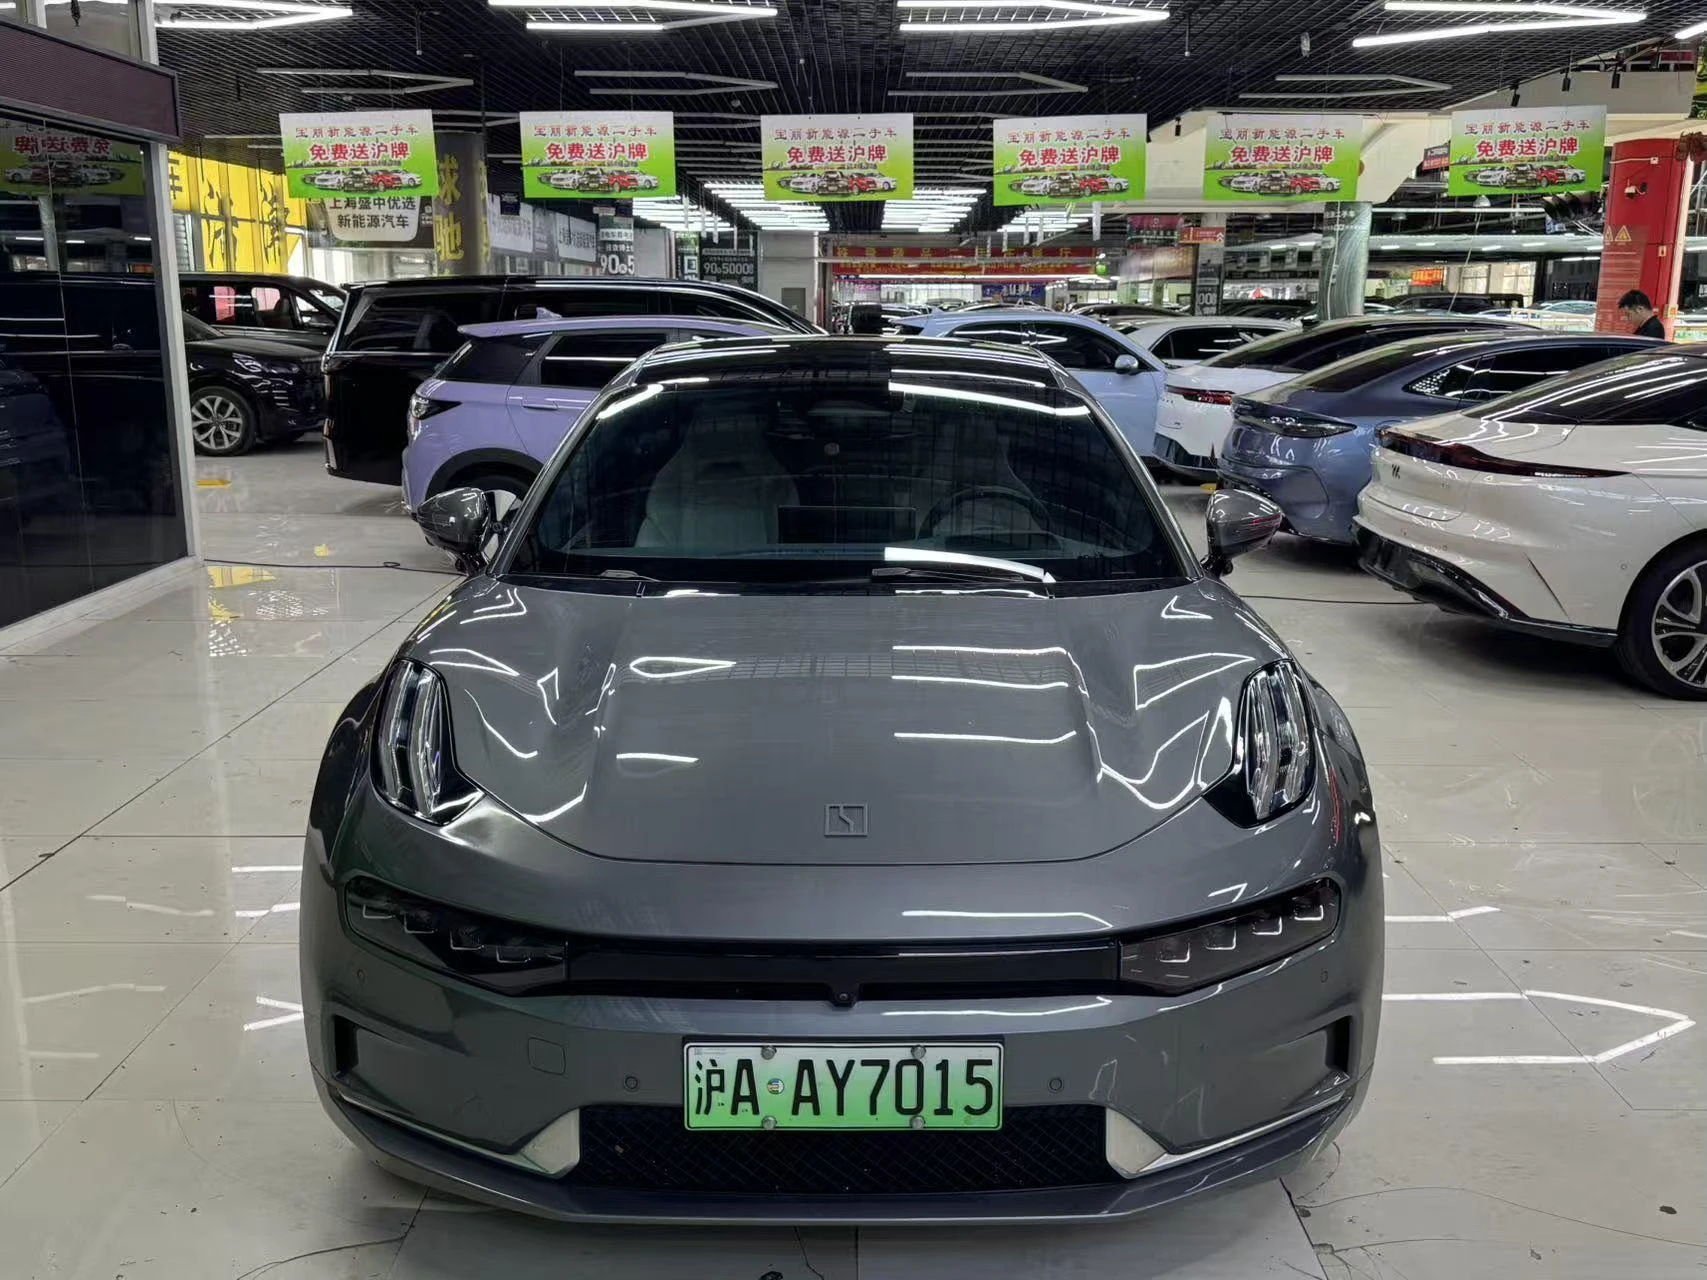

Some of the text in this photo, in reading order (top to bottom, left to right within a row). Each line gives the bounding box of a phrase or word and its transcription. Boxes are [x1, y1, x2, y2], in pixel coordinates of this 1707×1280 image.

[309, 142, 410, 160] 免费送沪牌
[546, 143, 648, 160] 免费送沪牌
[787, 145, 888, 163] 免费送沪牌
[1019, 145, 1121, 166] 免费送沪牌
[1231, 145, 1334, 163] 免费送沪牌
[1477, 137, 1579, 157] 免费送沪牌
[329, 196, 417, 211] 上海盛中优选
[337, 214, 409, 229] 新能源汽车
[695, 1059, 994, 1116] 沪A AY7015
